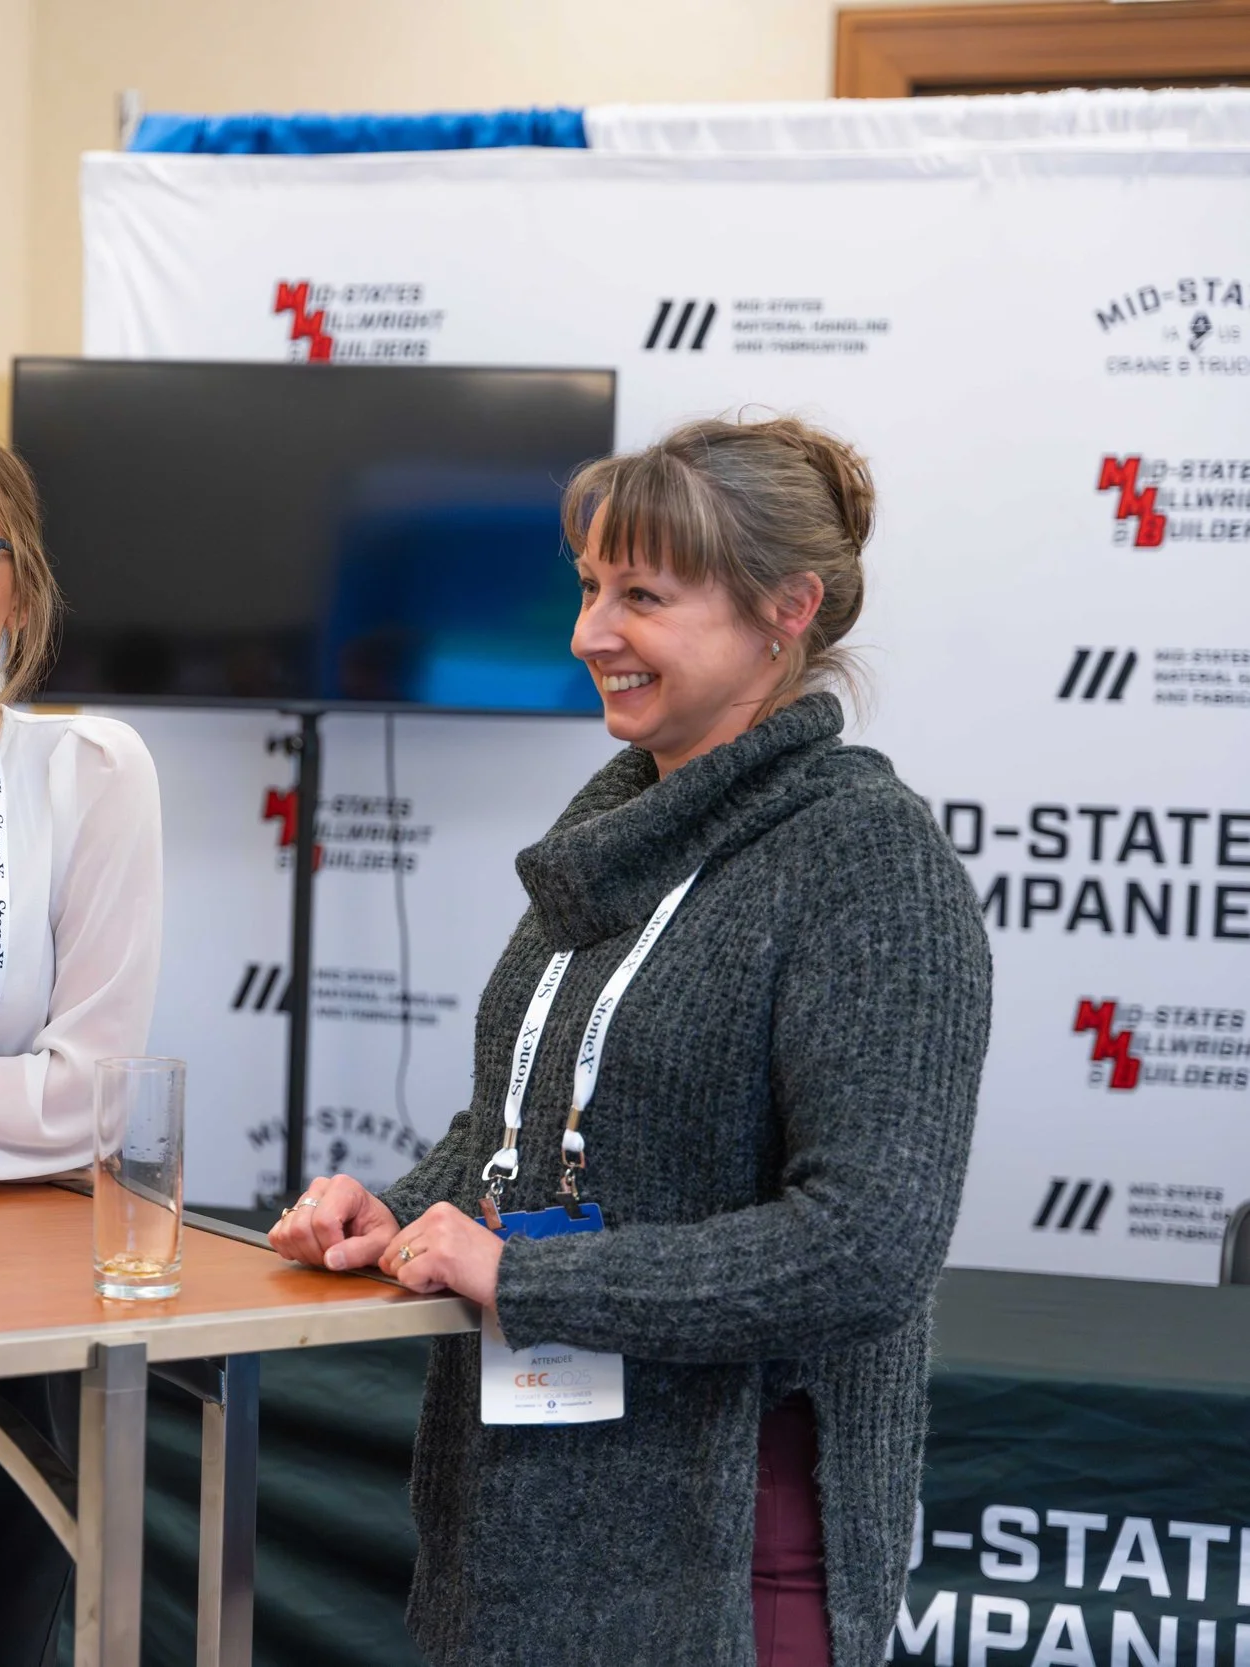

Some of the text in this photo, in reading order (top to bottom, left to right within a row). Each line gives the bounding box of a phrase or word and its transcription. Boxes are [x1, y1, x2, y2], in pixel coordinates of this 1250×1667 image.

[511, 1021, 539, 1097] StoneX
[579, 996, 614, 1074] StoneX
[531, 1354, 573, 1366] ATTENDEE
[909, 1500, 1250, 1607] -STAT
[885, 1590, 1250, 1667] MPANI
